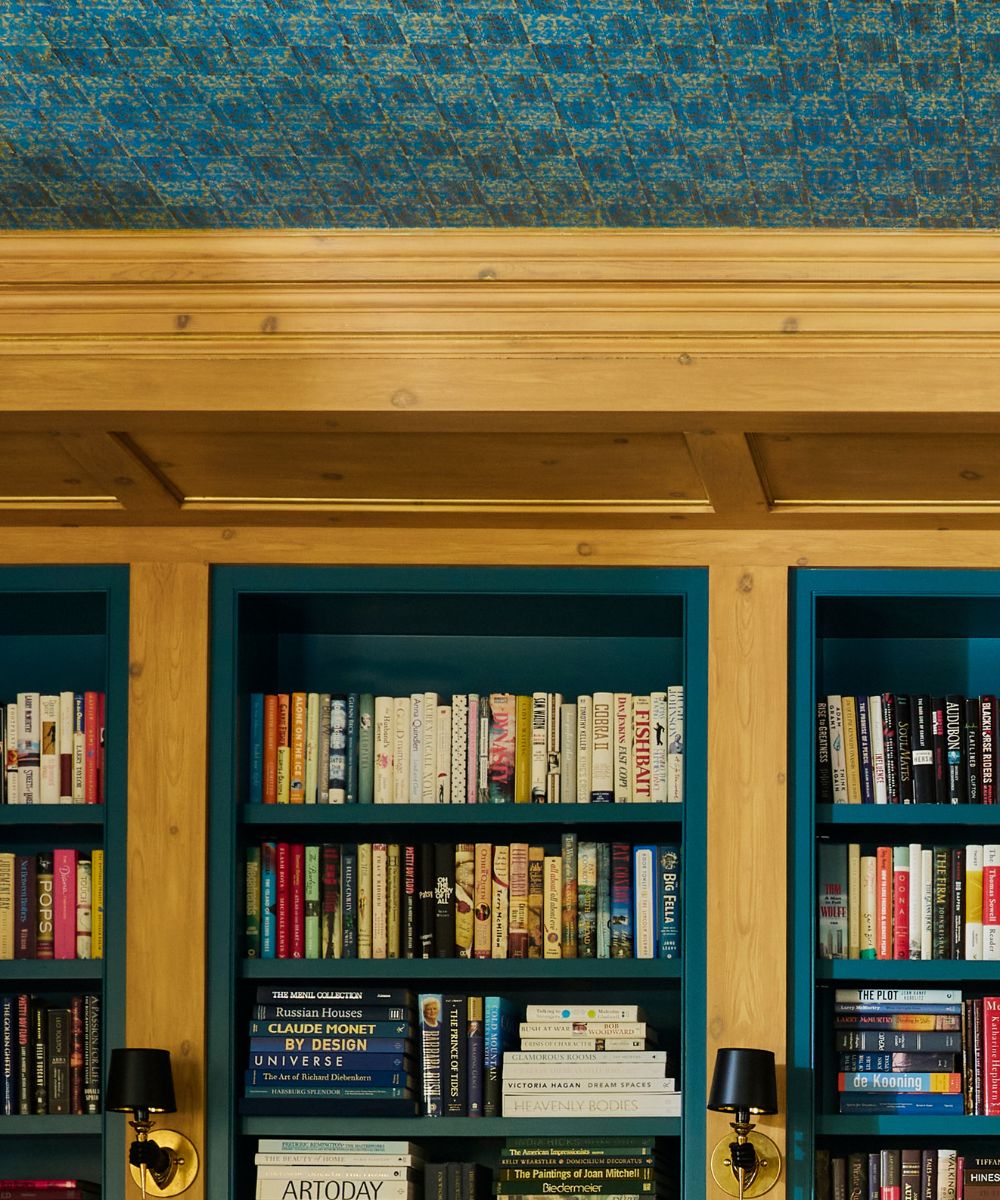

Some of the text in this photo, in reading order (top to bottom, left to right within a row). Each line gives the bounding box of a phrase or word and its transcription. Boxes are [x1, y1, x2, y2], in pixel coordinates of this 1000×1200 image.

[533, 697, 545, 730] SAM WALTON
[618, 697, 627, 711] DAN
[818, 703, 827, 718] RISE
[295, 727, 302, 741] ON
[594, 704, 609, 740] COBRA
[946, 702, 960, 750] AUDUBON
[491, 712, 509, 784] DYNASTY
[618, 745, 627, 765] FAST
[636, 710, 650, 797] FISHBAIT
[818, 726, 827, 763] GREATNESS
[618, 766, 627, 788] COPY
[875, 753, 884, 783] INFLUENCE
[982, 754, 992, 783] RIDERS
[936, 852, 946, 874] THE
[58, 865, 70, 895] Diana
[936, 877, 946, 903] FIRM
[39, 880, 52, 933] POPS
[663, 873, 677, 923] BIG FELLA
[858, 990, 898, 1000] THE PLOT
[275, 1007, 363, 1018] Russian Houses
[3, 1003, 11, 1077] THE GOLDEN GHETTO
[91, 996, 99, 1084] A PASSION FOR LIFE
[267, 1024, 376, 1034] CLAUDE MONET
[285, 1039, 367, 1051] BY DESIGN
[450, 1009, 458, 1097] THE PRINCE OF TIDES
[490, 1005, 498, 1081] COLD MOUNTAIN
[254, 1056, 343, 1066] UNIVERSE
[422, 1030, 440, 1096] BARBARA BUSH
[990, 1016, 1000, 1100] Katharine Hepburn
[262, 1073, 372, 1081] The Art of Richard Diebenkorn
[854, 1074, 922, 1091] de Kooning
[513, 1100, 638, 1112] HEAVENLY BODIES
[514, 1169, 640, 1180] The Paintings of Joan Mitchell
[853, 1163, 861, 1184] Pirate
[282, 1180, 383, 1200] ARTODAY
[542, 1183, 603, 1193] Biedermeier
